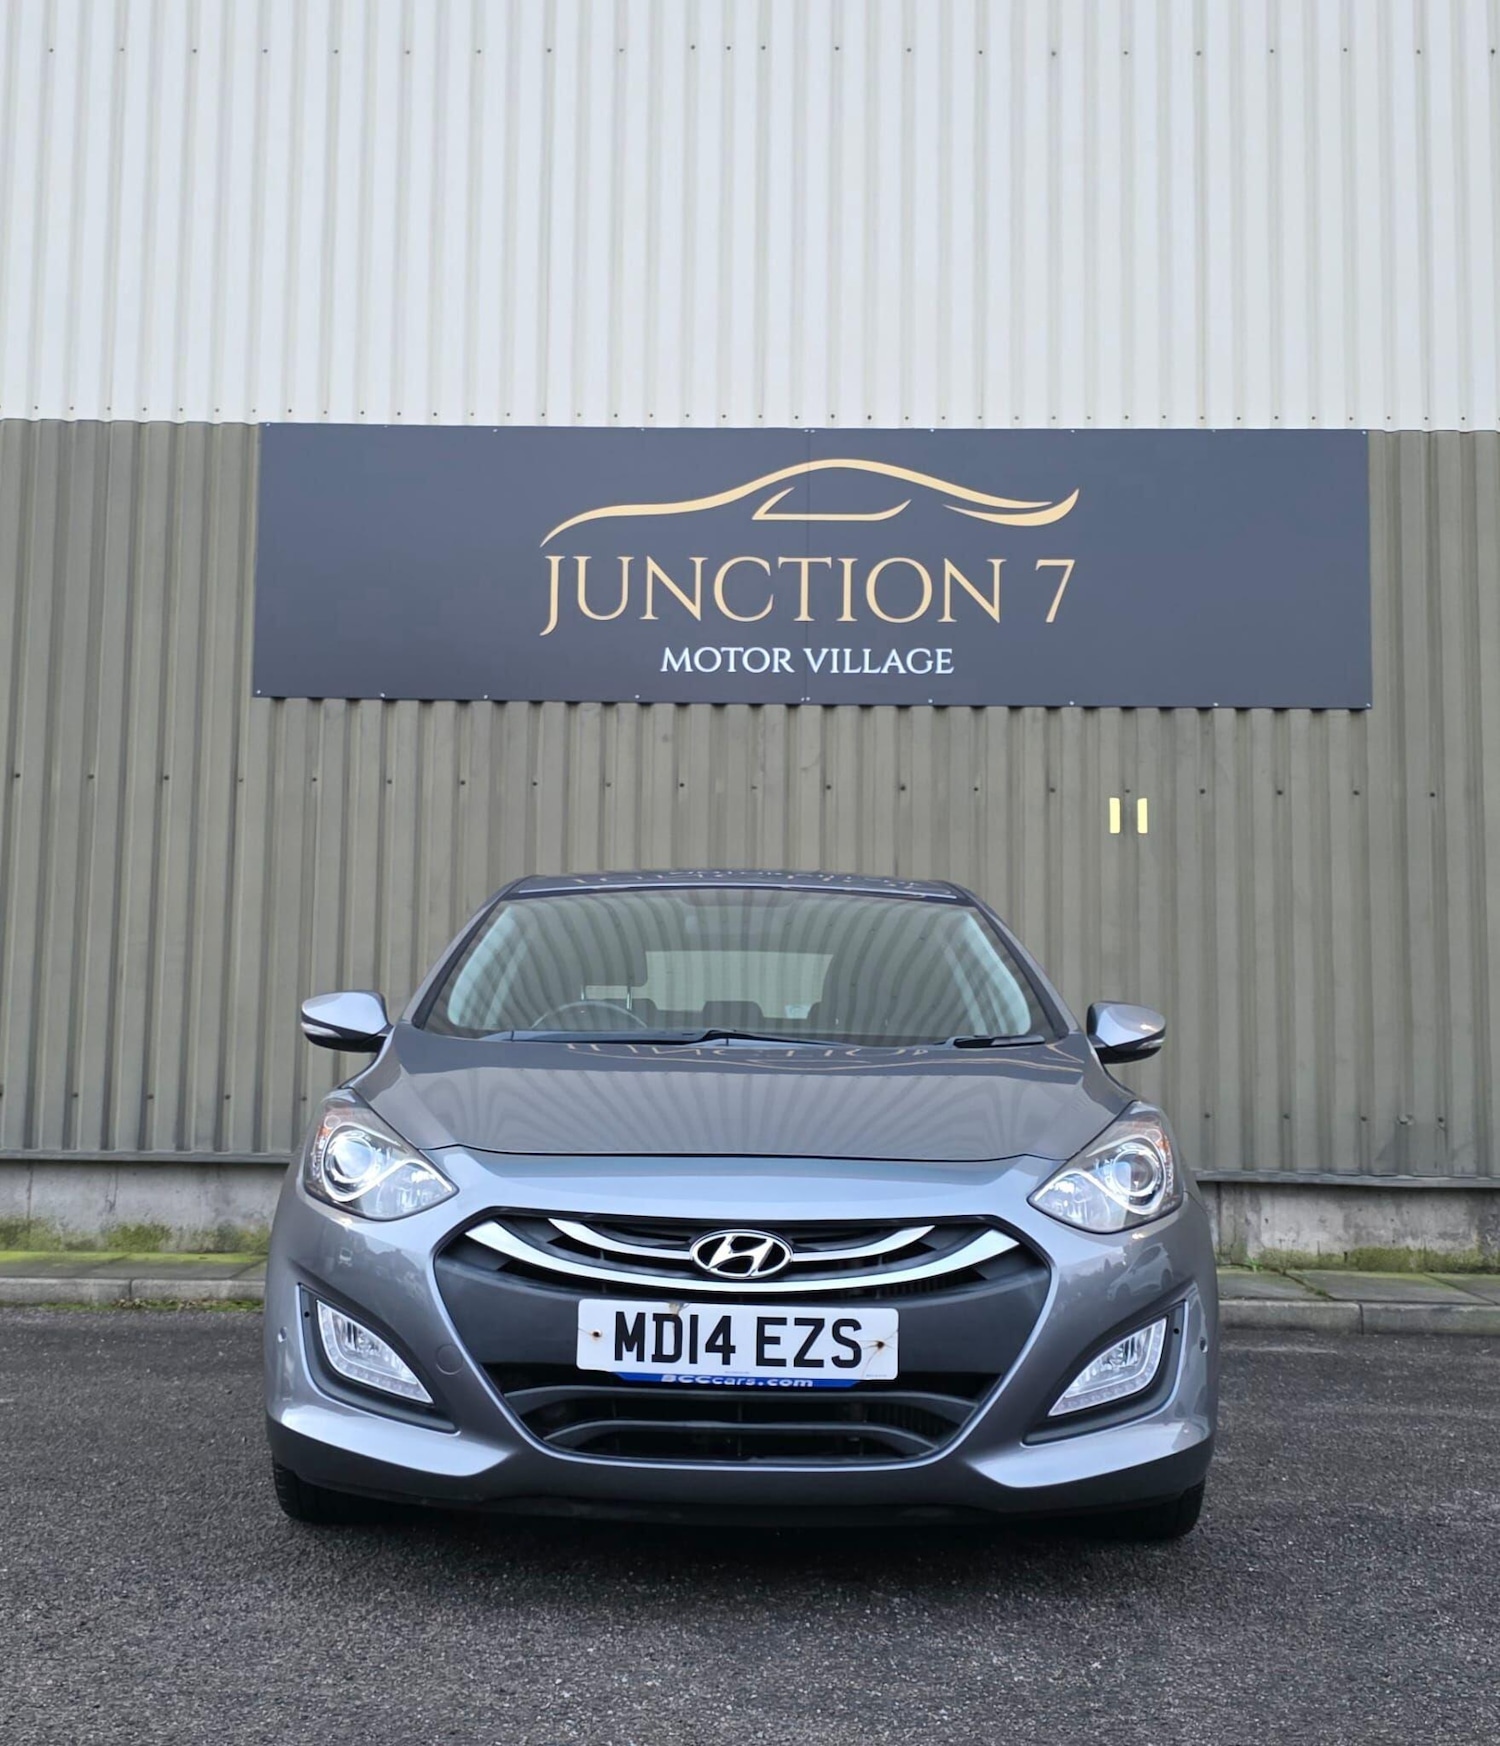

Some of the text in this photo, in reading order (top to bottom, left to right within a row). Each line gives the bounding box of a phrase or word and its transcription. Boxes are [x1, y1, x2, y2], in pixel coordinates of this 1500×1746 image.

[540, 556, 1077, 636] JUNCTION 7
[660, 646, 955, 675] MOTOR VILLAGE
[614, 1311, 862, 1369] MD14 EZS
